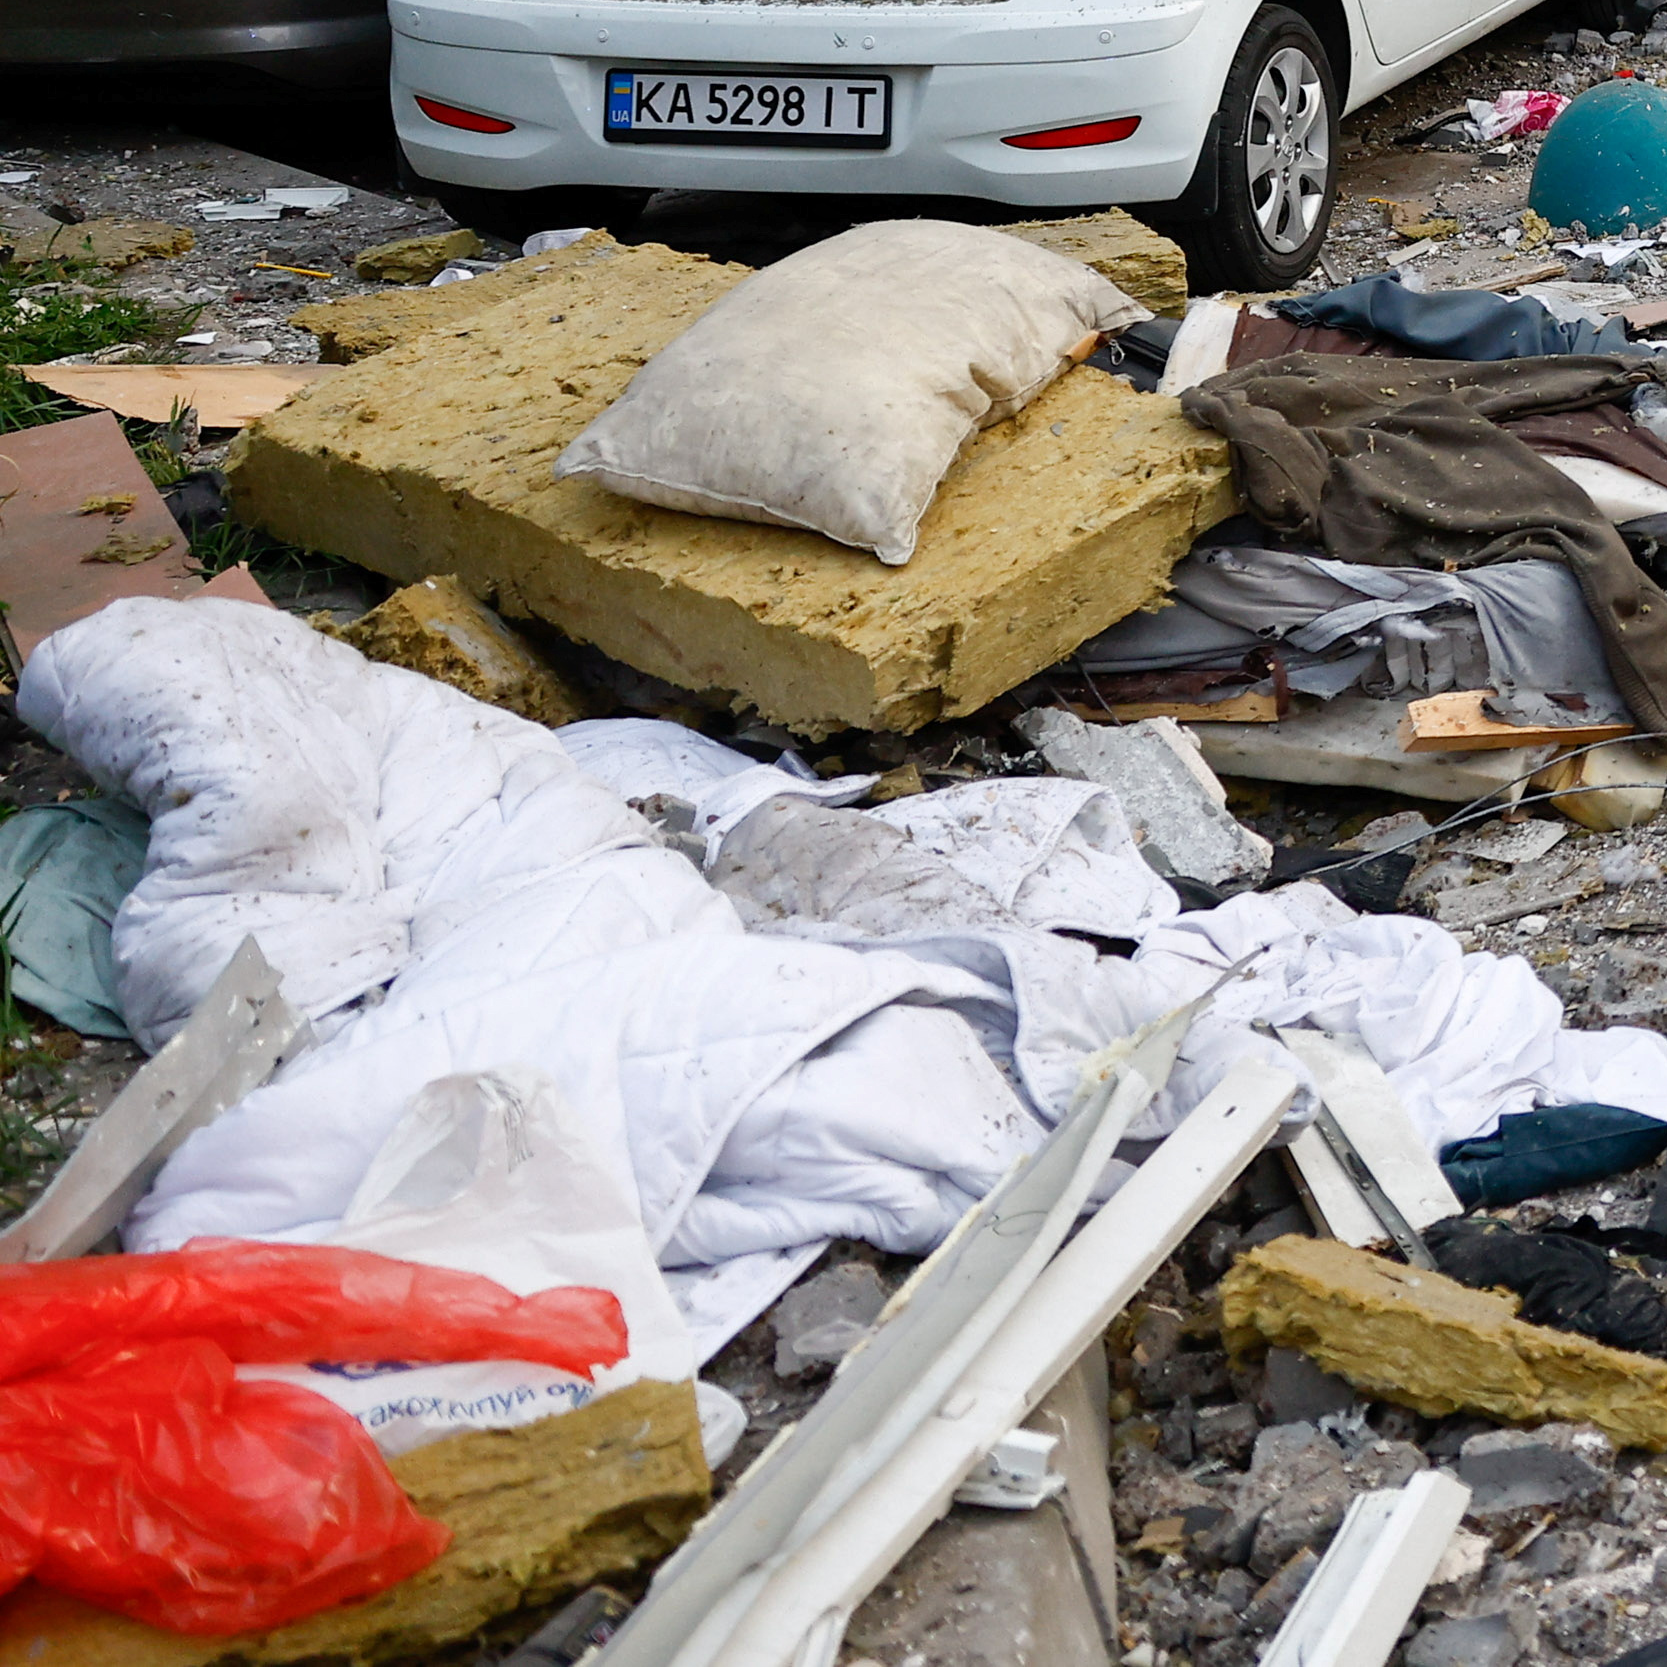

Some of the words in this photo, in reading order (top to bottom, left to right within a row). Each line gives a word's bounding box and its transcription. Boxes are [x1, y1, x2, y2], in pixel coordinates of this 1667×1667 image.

[611, 109, 630, 124] UA
[635, 81, 695, 124] KA
[705, 83, 806, 127] 5298
